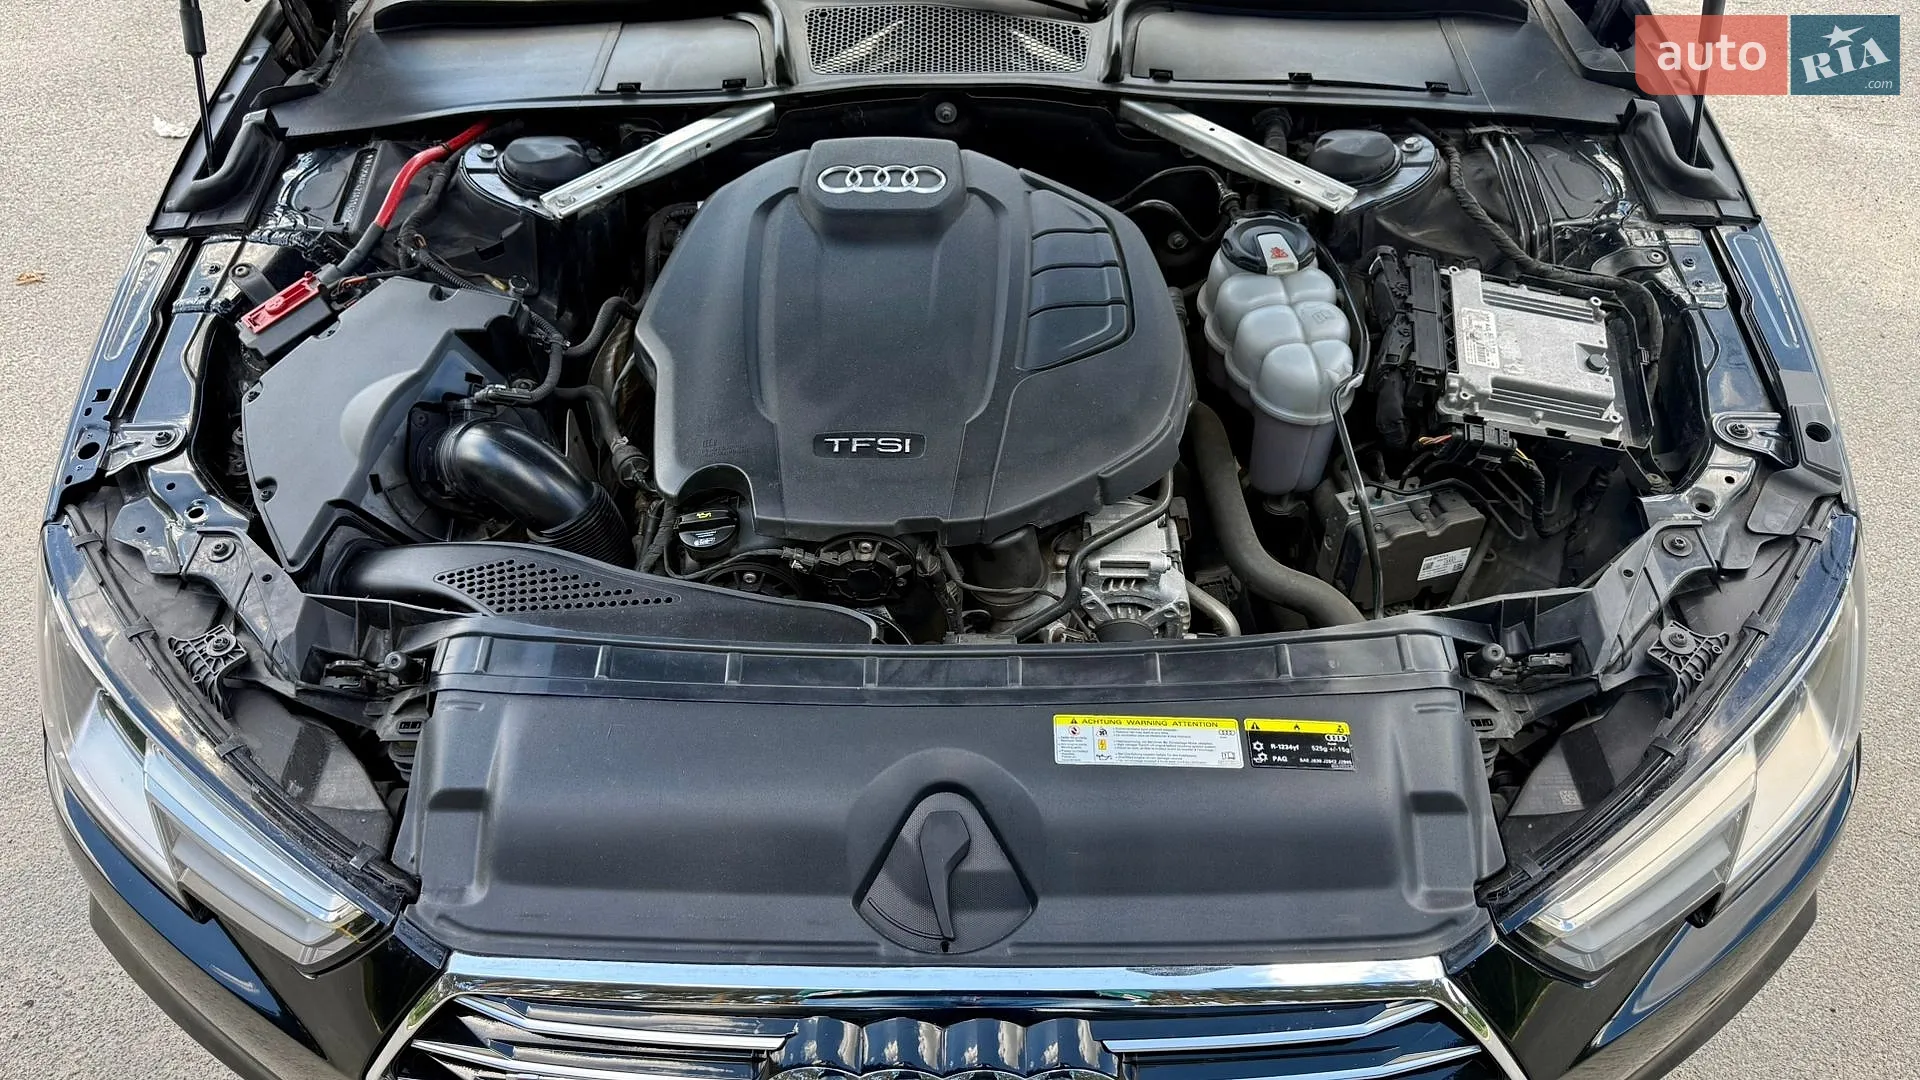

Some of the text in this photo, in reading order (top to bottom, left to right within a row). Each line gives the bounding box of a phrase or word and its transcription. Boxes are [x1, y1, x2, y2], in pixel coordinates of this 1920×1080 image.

[824, 437, 911, 453] TFSI
[1172, 720, 1218, 728] ATTENTION
[1272, 755, 1288, 763] PAG
